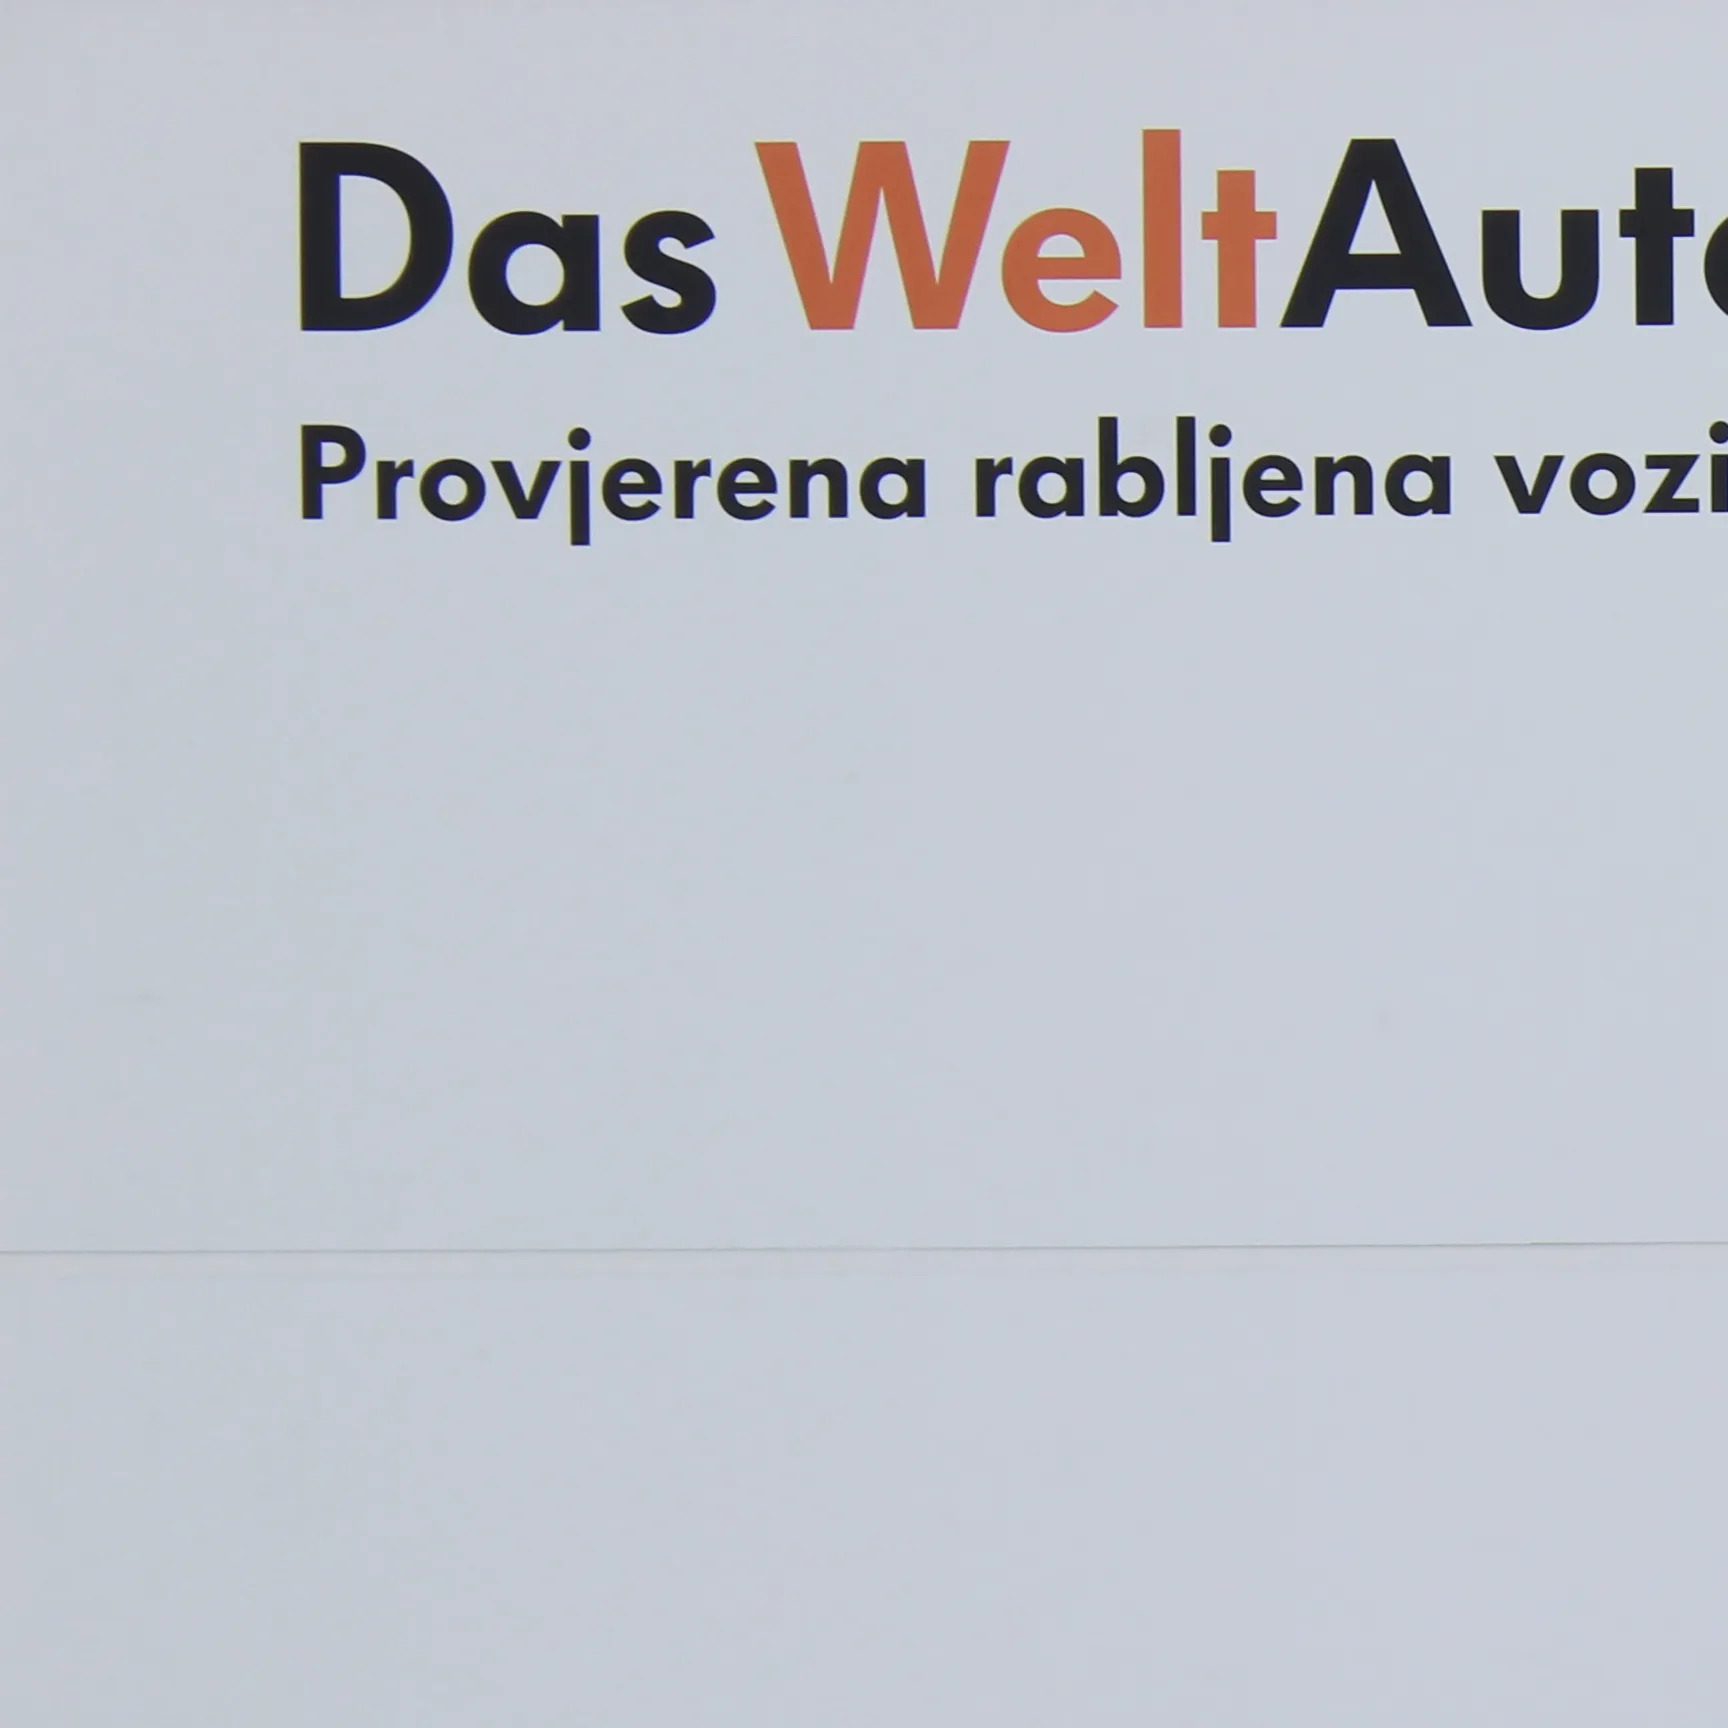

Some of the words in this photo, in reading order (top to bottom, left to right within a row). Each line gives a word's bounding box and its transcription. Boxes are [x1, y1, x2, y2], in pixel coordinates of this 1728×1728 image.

[299, 141, 717, 336] Das
[300, 424, 926, 546] Provjerena
[975, 415, 1451, 543] rabljena
